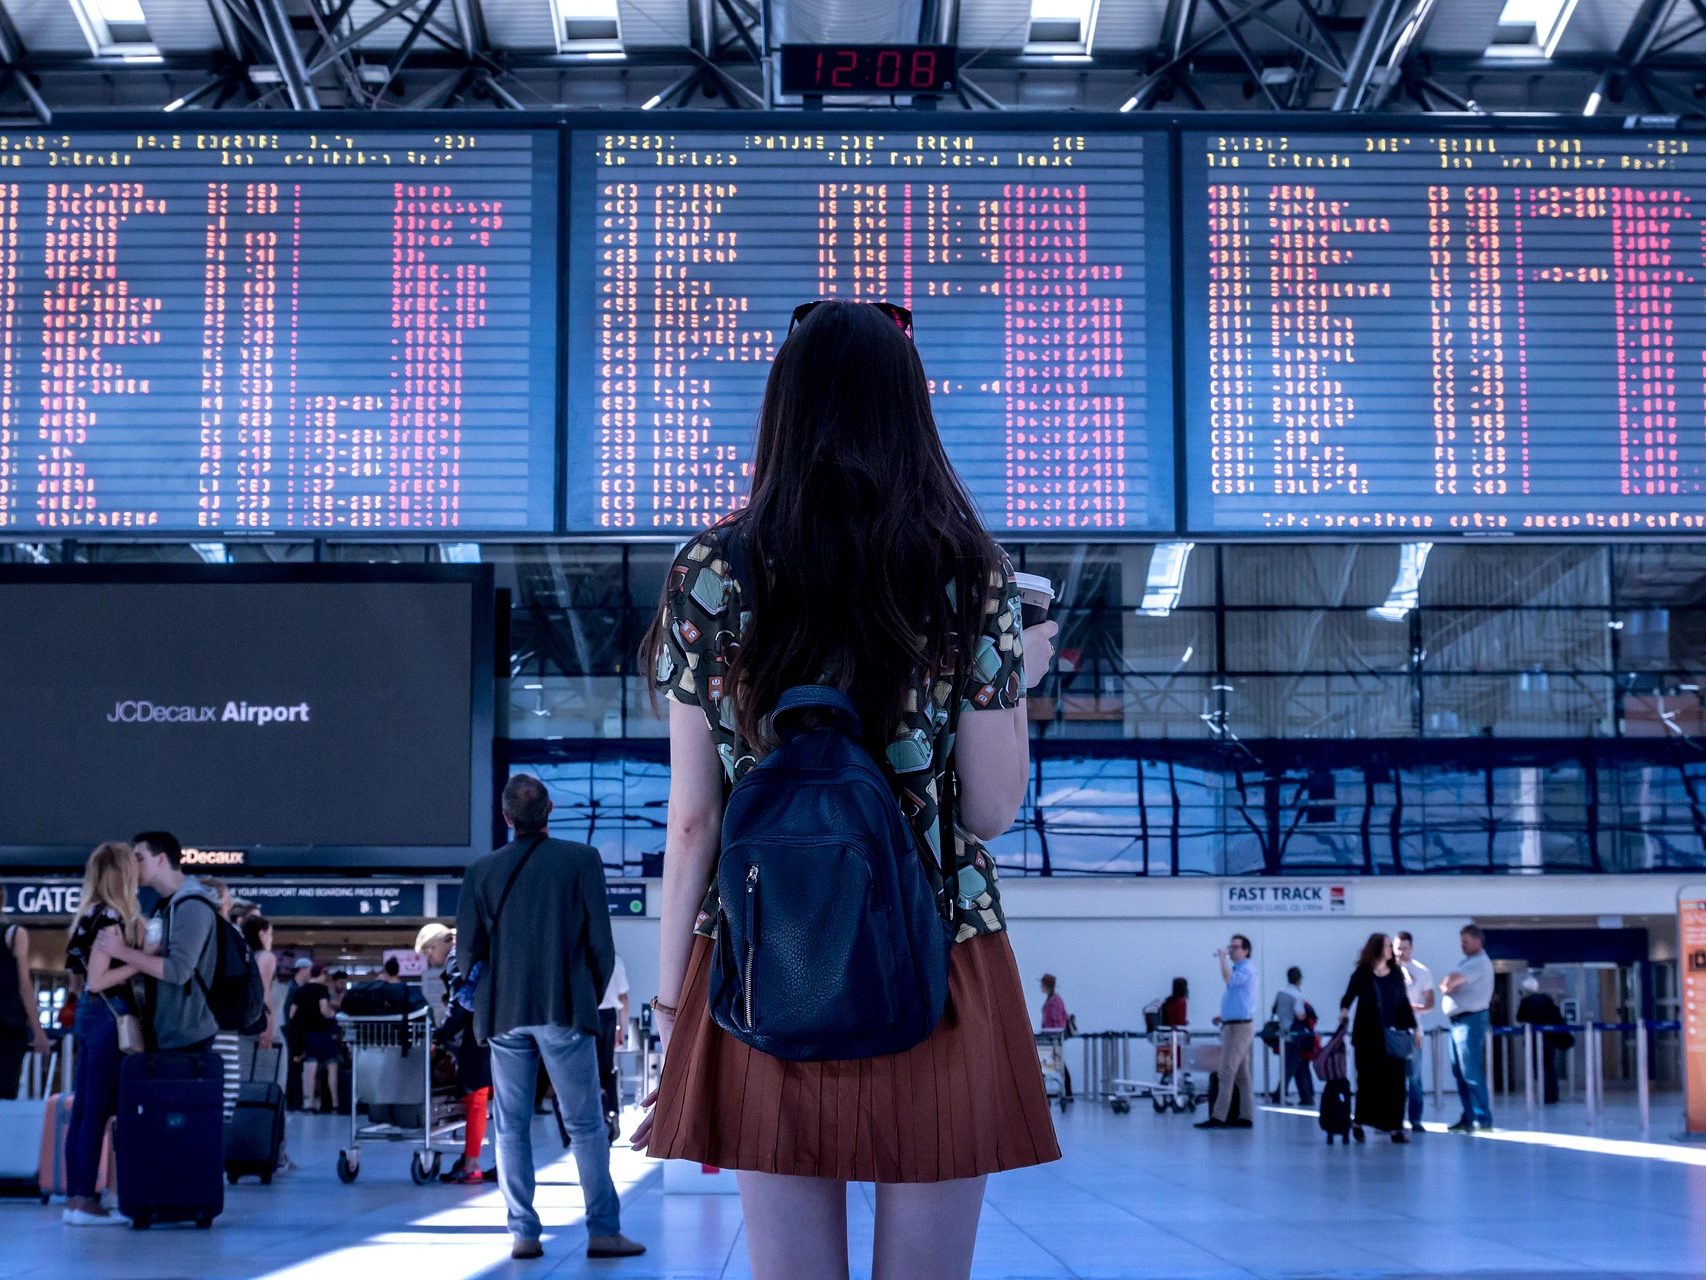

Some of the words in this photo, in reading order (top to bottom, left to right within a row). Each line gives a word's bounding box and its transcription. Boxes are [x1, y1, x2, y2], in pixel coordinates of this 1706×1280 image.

[815, 50, 936, 87] 12:08
[107, 700, 216, 722] JCDecaux
[221, 701, 310, 726] Airport
[258, 887, 297, 897] PASSPORT
[297, 887, 314, 897] AND
[315, 887, 354, 897] BOARDING
[354, 887, 373, 897] PASS
[374, 887, 400, 897] READY
[1228, 886, 1266, 901] FAST
[1272, 886, 1323, 901] TRACK
